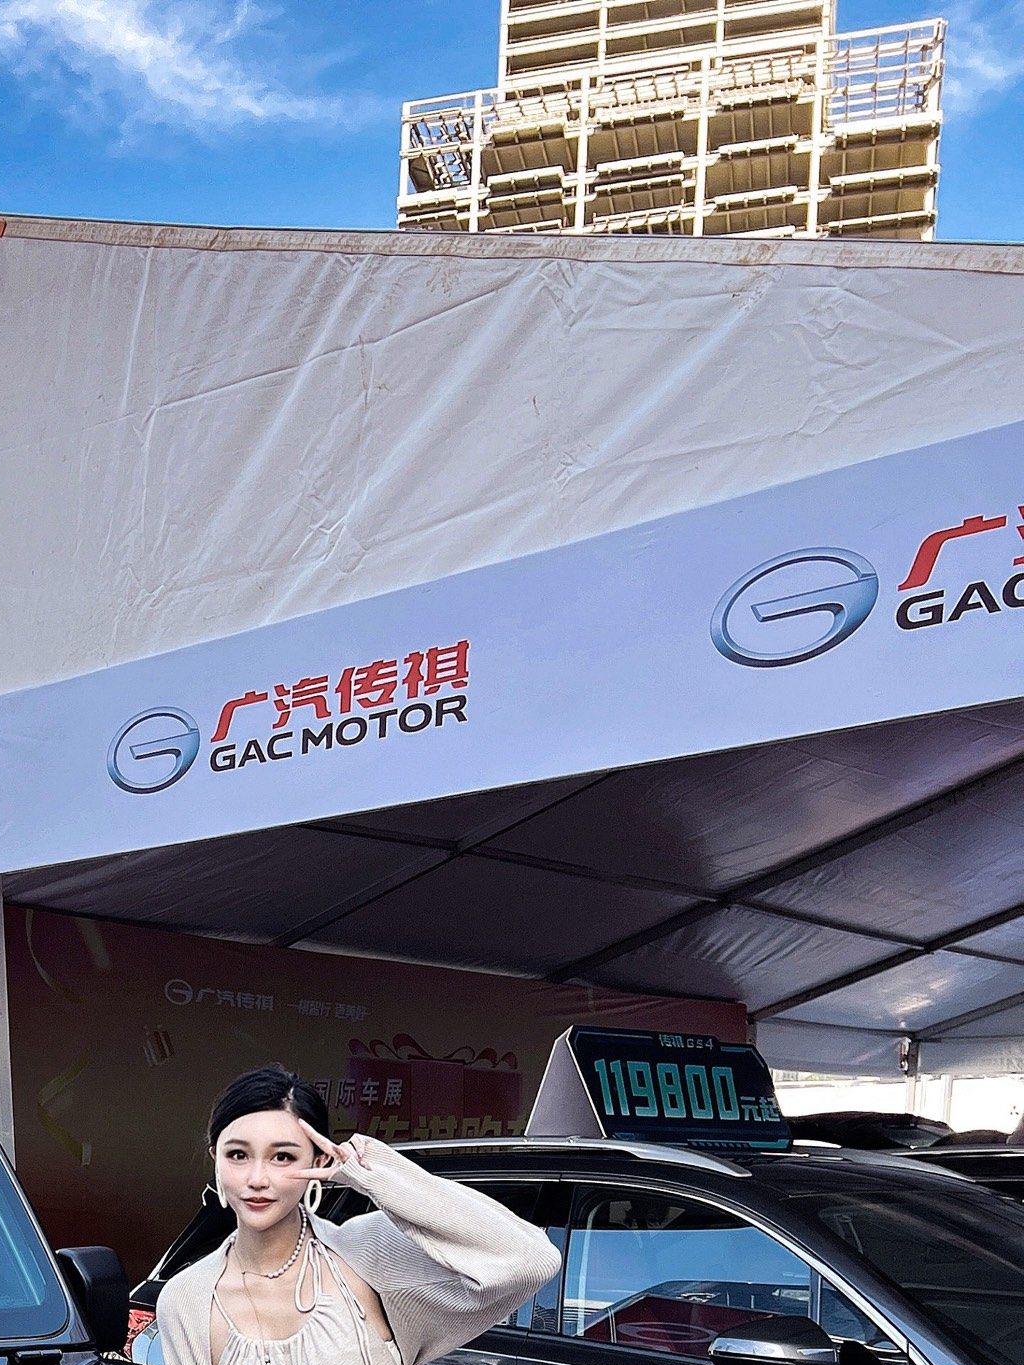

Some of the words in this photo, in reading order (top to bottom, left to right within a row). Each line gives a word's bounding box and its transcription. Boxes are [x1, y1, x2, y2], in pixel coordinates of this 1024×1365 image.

[898, 505, 1024, 591] 广
[213, 639, 471, 743] 广汽传祺
[209, 732, 297, 772] GAC
[301, 695, 468, 755] MOTOR
[196, 988, 275, 1011] 广汽传祺
